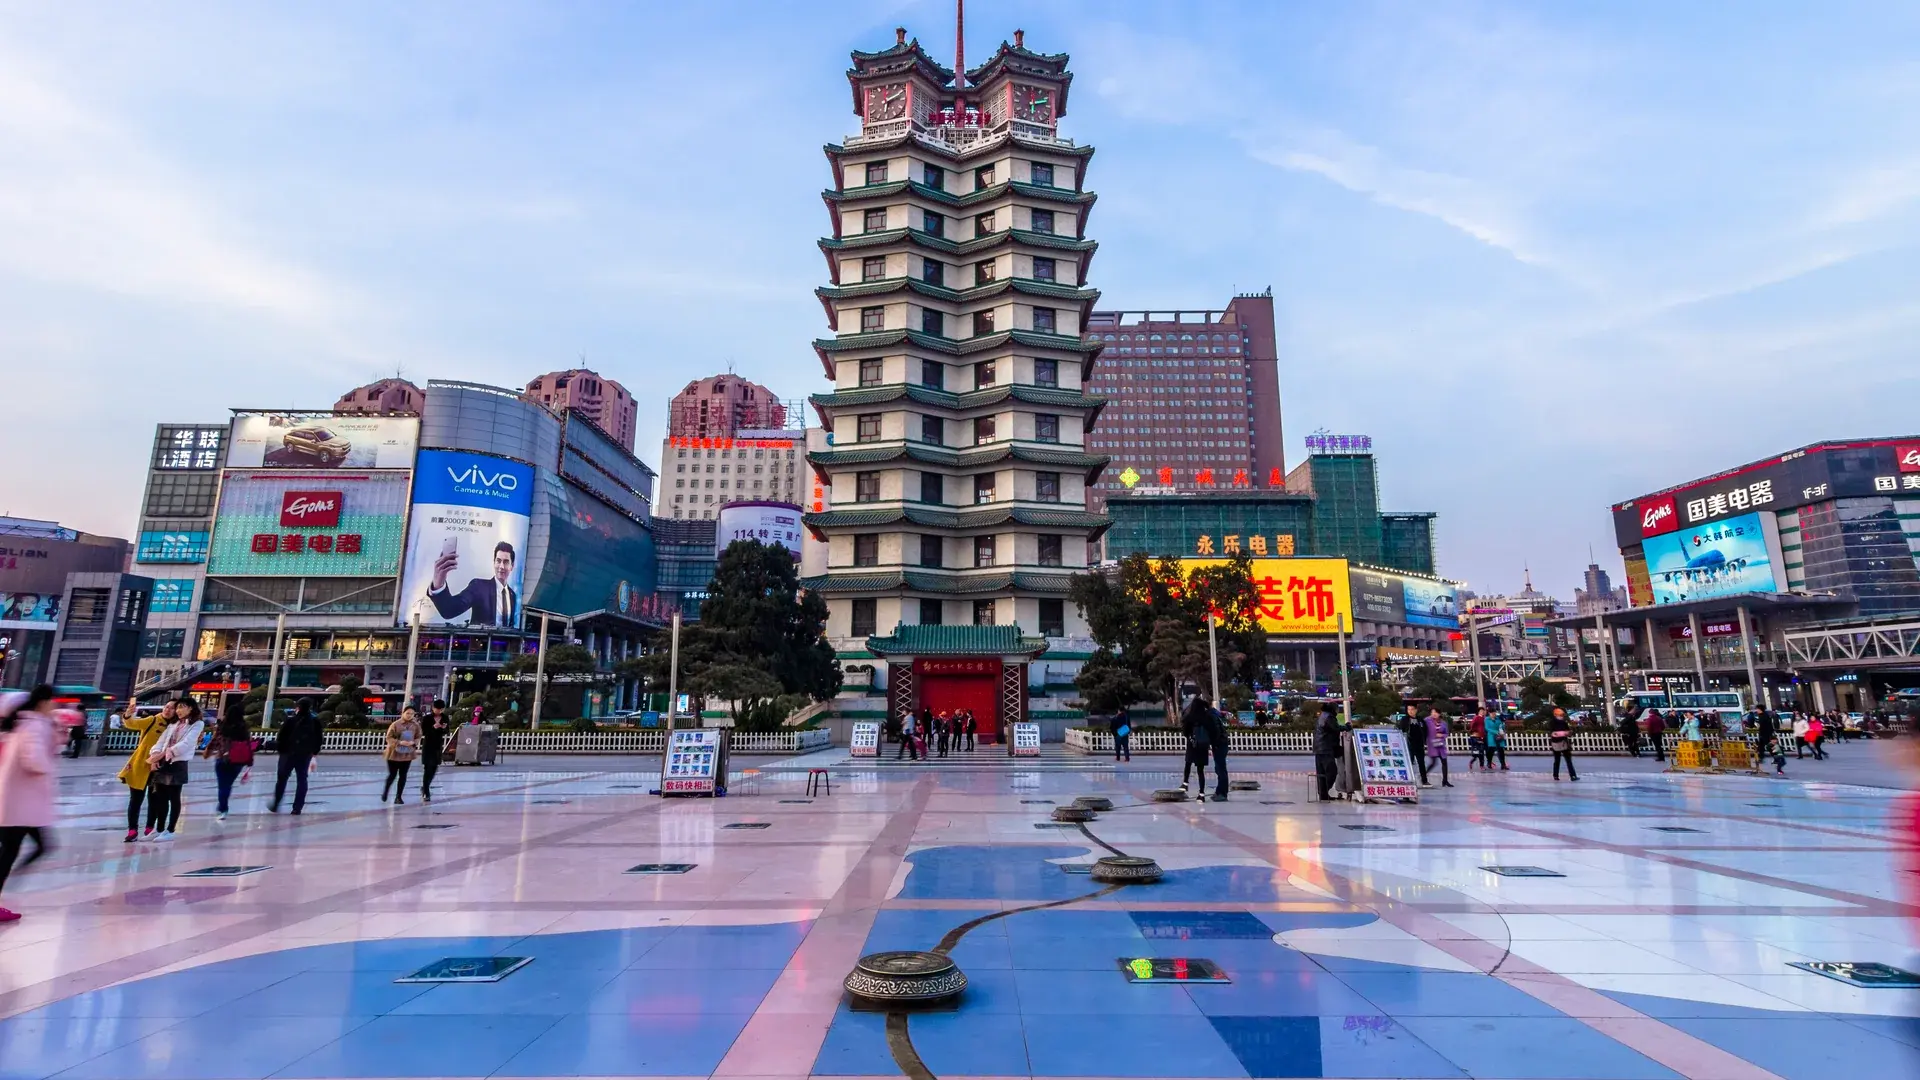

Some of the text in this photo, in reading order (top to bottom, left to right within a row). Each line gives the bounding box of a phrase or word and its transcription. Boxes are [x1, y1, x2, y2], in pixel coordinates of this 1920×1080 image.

[174, 430, 219, 448] 华联
[170, 450, 217, 468] 酒店
[447, 464, 518, 490] vivo
[1157, 466, 1286, 486] 商城大厦
[454, 485, 510, 499] Camera & Music
[1802, 483, 1828, 499] 1F-3F
[1687, 479, 1774, 523] 国美电器
[251, 533, 362, 553] 国美电器
[1703, 526, 1745, 543] 大韩航空
[1197, 534, 1295, 556] 永乐电器
[665, 780, 702, 791] 数码快相
[1366, 785, 1405, 796] 数码快相
